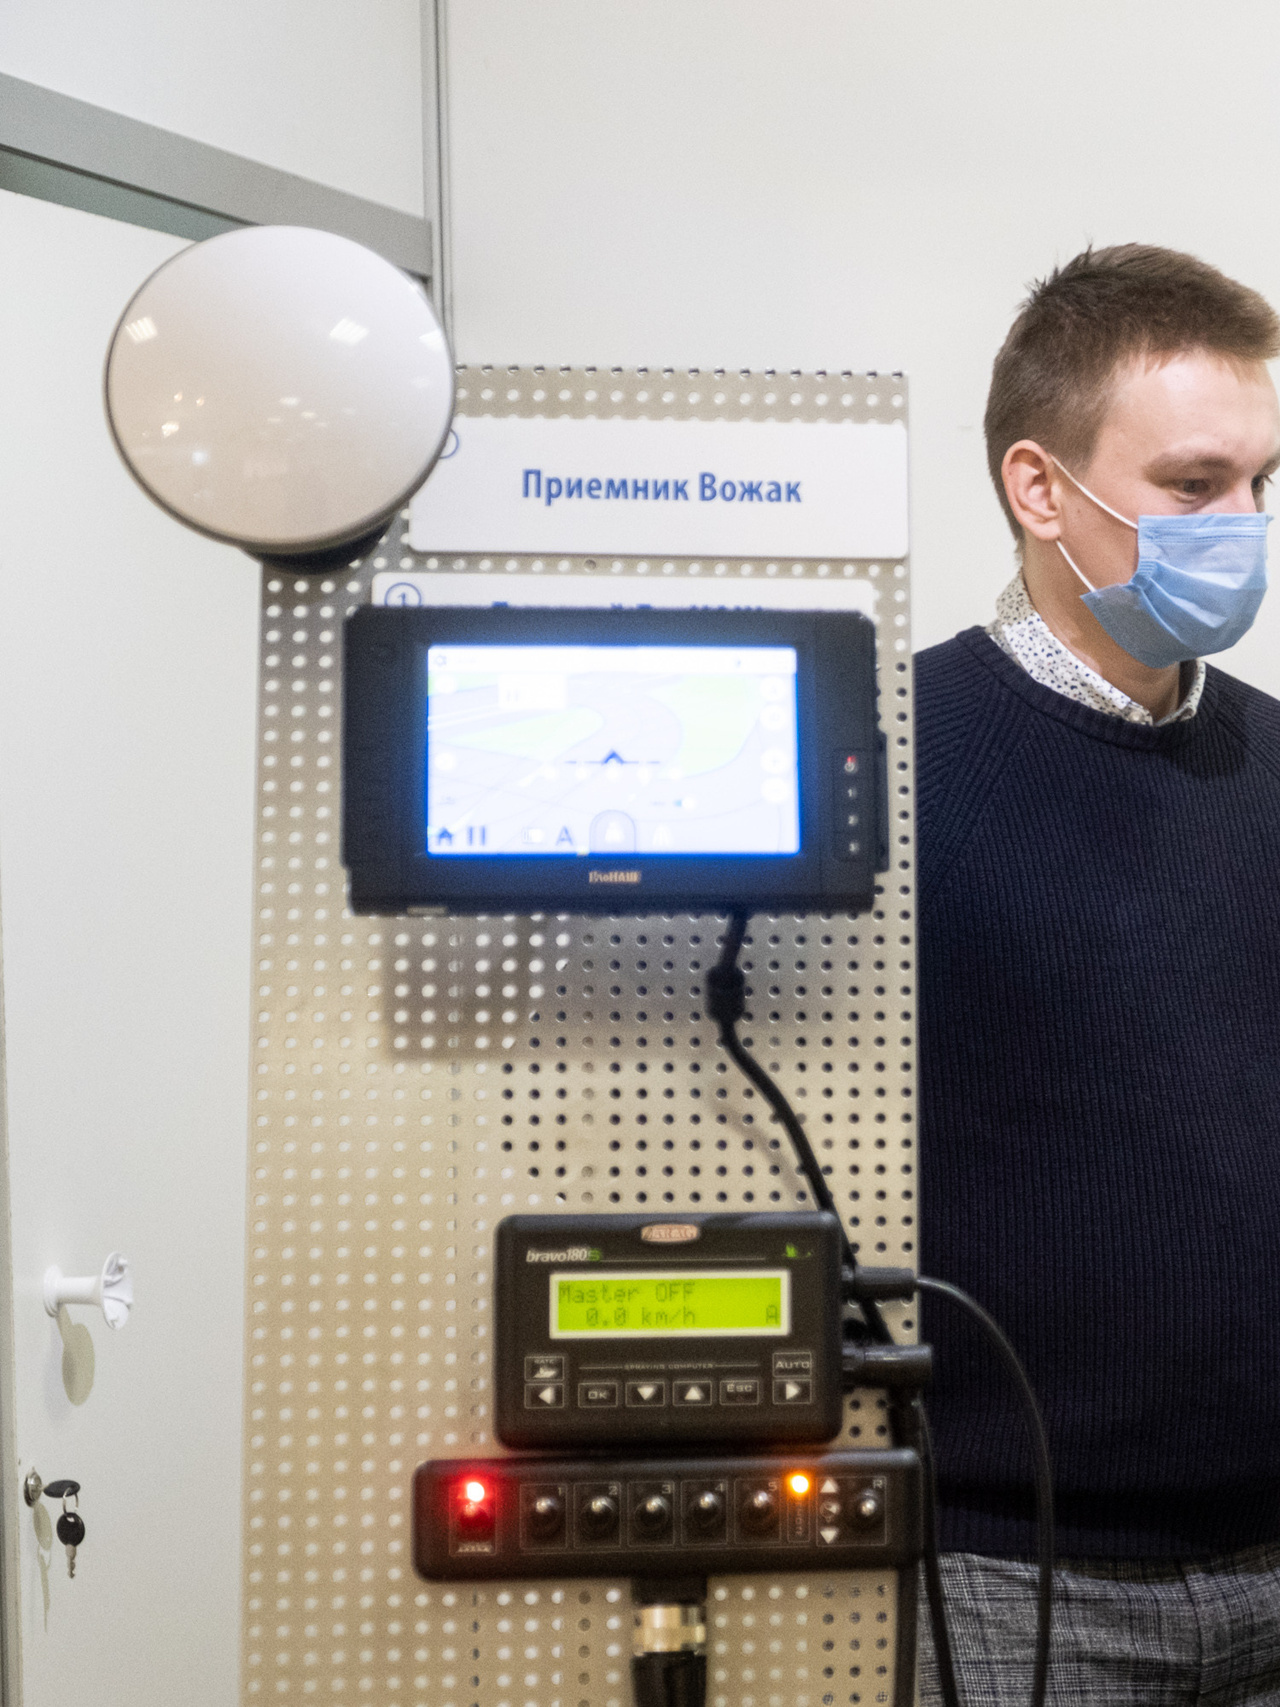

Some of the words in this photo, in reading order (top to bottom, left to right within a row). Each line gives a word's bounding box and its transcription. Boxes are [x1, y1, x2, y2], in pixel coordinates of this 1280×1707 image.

[521, 468, 690, 507] Приемник
[698, 471, 803, 503] Вожак
[558, 1284, 641, 1304] Master
[655, 1282, 696, 1302] OFF
[586, 1307, 627, 1327] 0.0
[641, 1304, 696, 1326] km/h
[766, 1305, 780, 1324] A
